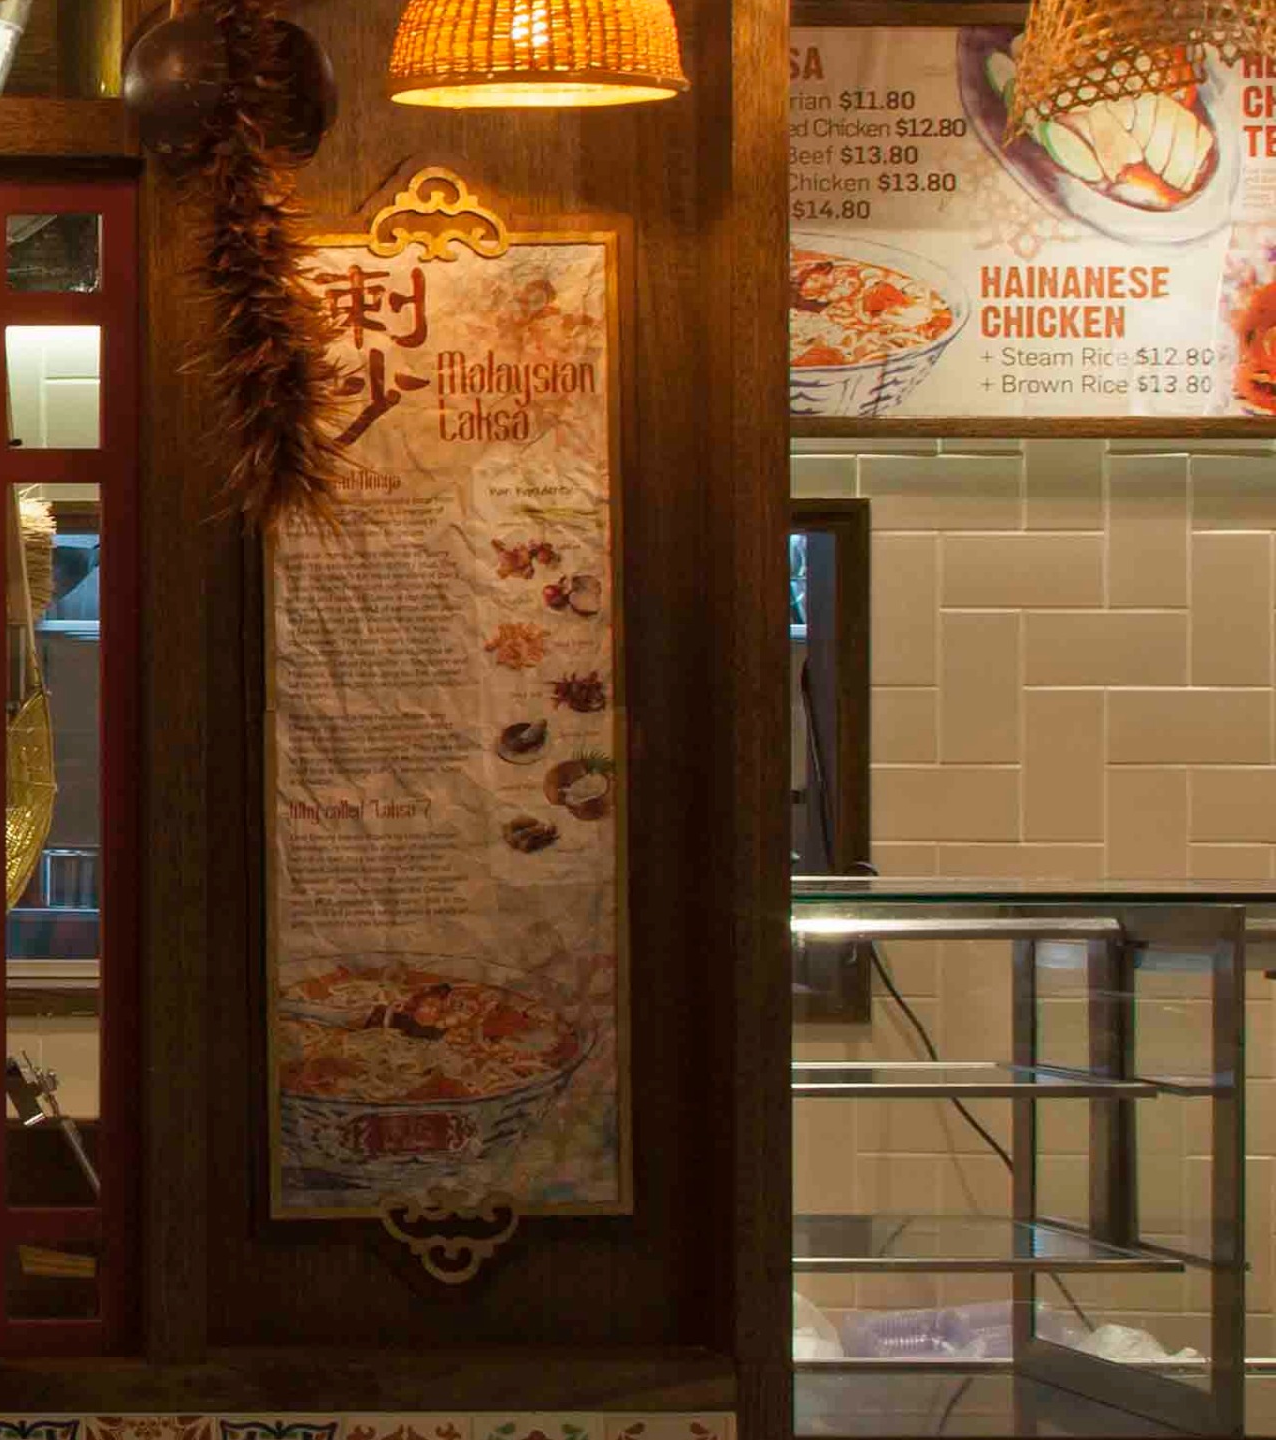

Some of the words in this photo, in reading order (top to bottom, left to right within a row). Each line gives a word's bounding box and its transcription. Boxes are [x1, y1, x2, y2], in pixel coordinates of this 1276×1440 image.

[839, 91, 916, 111] $11.80
[813, 119, 890, 137] Chicken
[895, 118, 967, 138] $12.80
[840, 145, 919, 165] $13.80
[878, 173, 957, 193] $13.80
[792, 200, 871, 220] $14.80
[981, 266, 1171, 299] HAINANESE
[981, 305, 1126, 339] CHICKEN
[1001, 347, 1074, 367] Steam
[1082, 347, 1129, 367] Rice
[1136, 347, 1214, 367] $12.80
[438, 350, 595, 407] Malaysian
[1001, 375, 1074, 393] Brown
[1082, 375, 1129, 393] Rice
[1138, 375, 1213, 393] $13.80
[439, 398, 529, 441] Laksa
